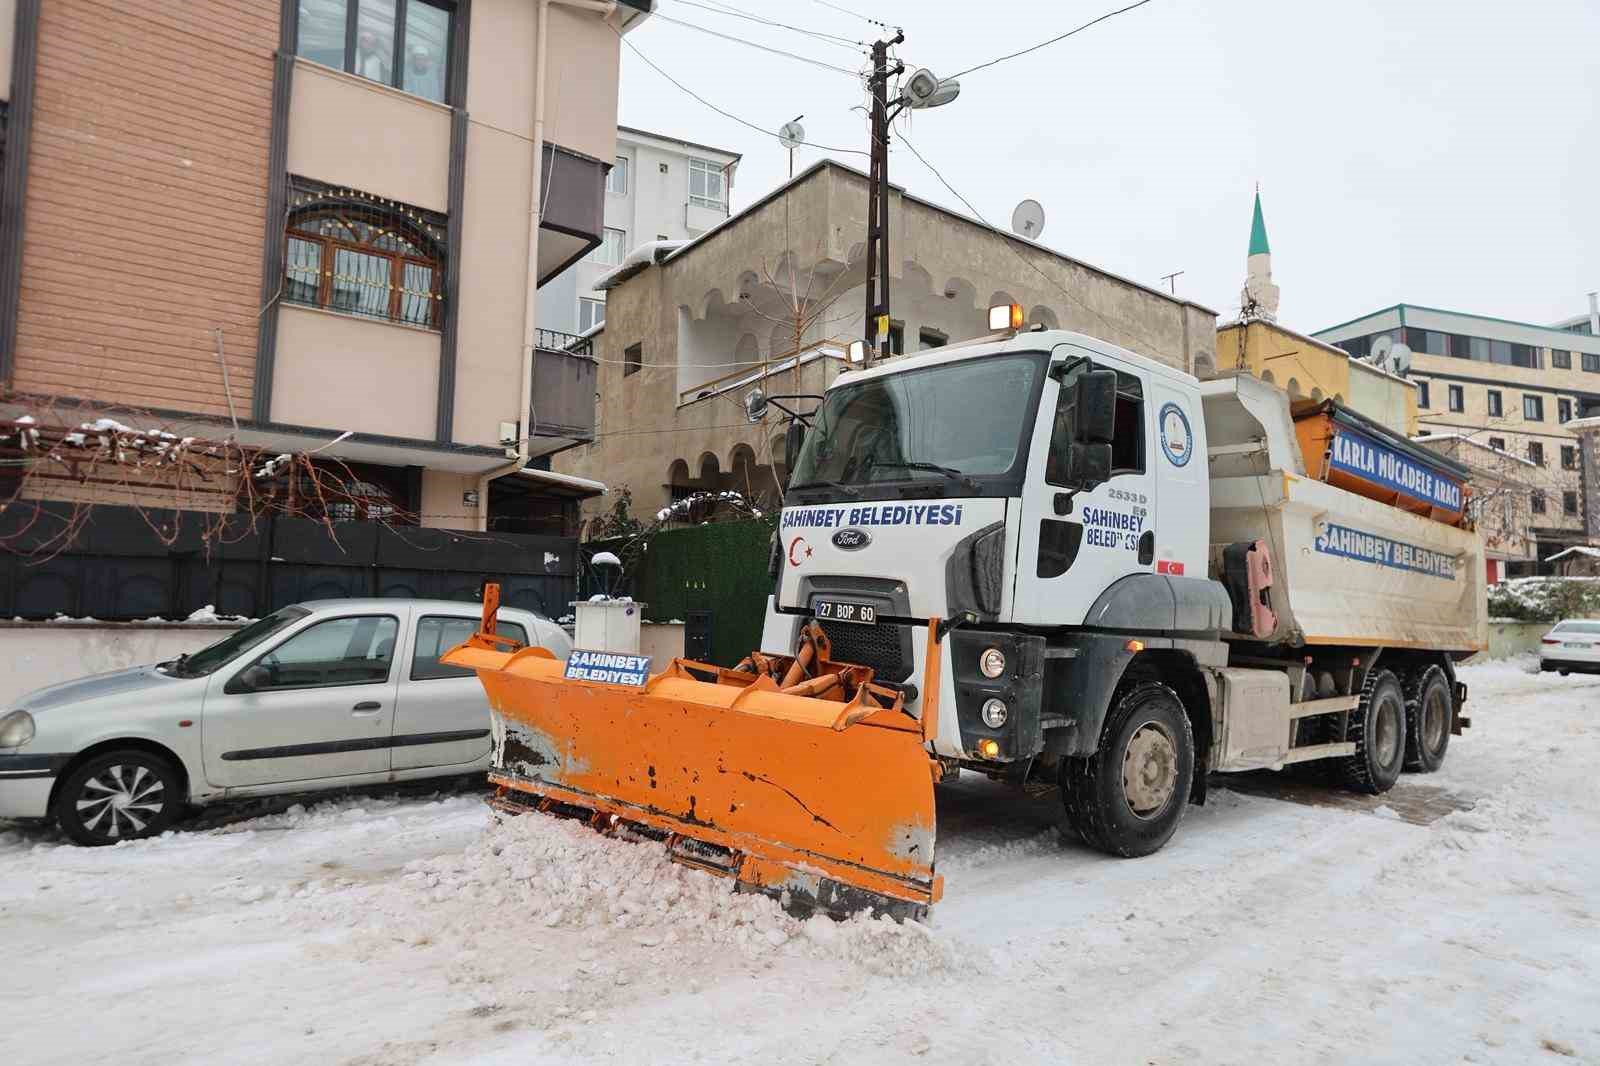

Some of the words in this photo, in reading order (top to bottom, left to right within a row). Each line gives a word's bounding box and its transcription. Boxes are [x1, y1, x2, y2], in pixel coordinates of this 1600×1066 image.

[1334, 435, 1374, 473] KARLA
[1379, 452, 1432, 497] MÜCADELE
[1434, 480, 1460, 508] ARACI
[838, 531, 860, 545] Ford
[820, 602, 831, 616] 27
[837, 604, 854, 619] BOP
[860, 607, 873, 621] 60
